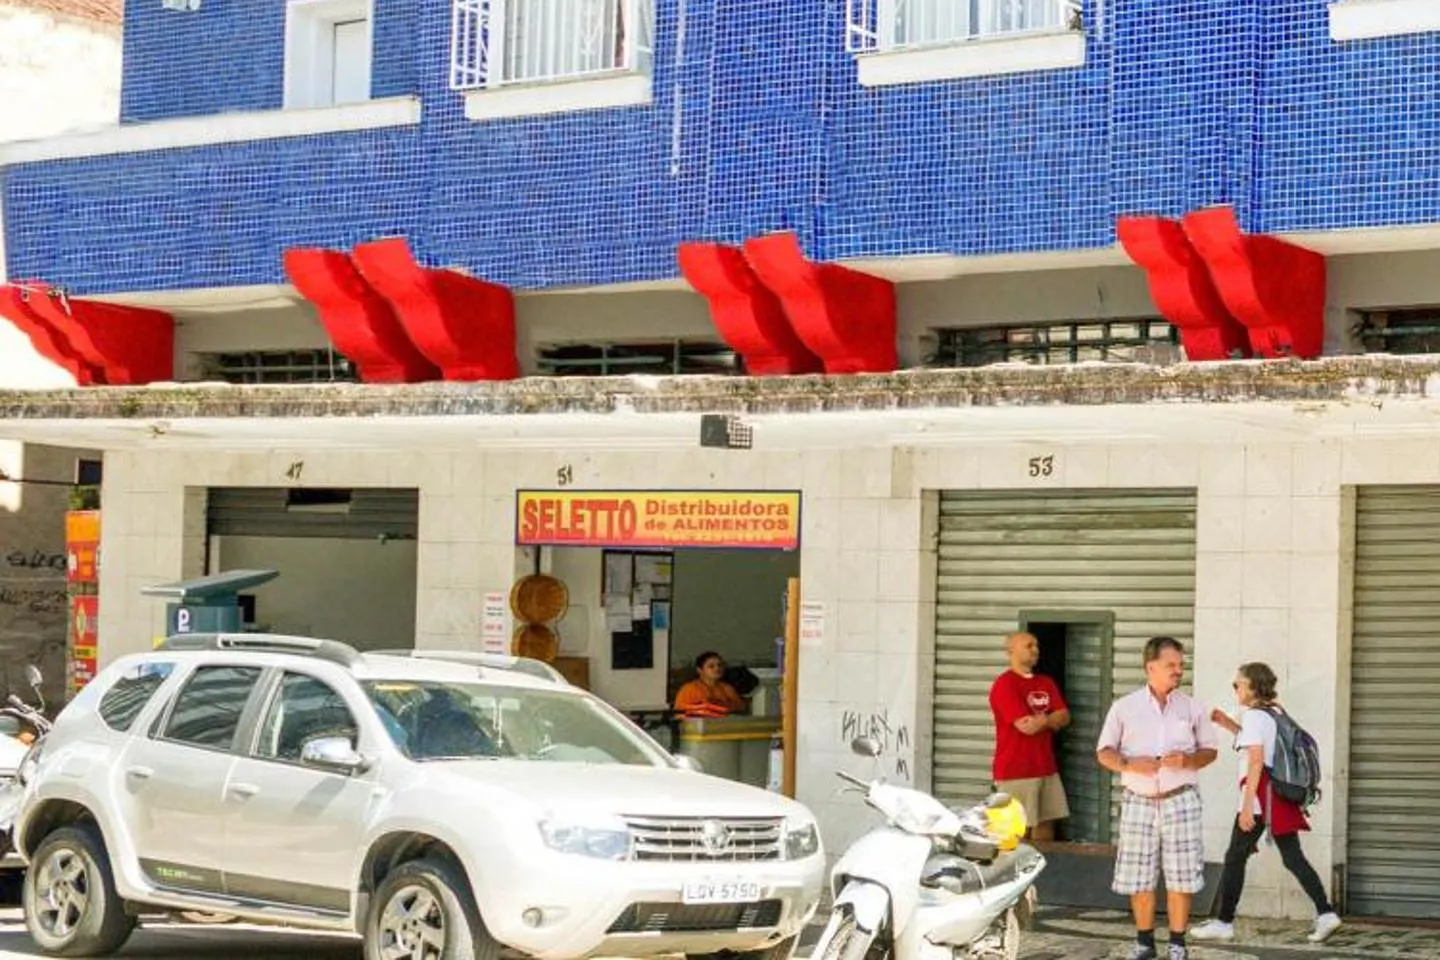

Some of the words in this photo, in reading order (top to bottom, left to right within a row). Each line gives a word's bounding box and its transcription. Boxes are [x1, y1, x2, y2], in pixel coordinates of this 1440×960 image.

[557, 465, 573, 486] 51
[1028, 455, 1053, 477] 53
[645, 500, 789, 517] Distribuidora
[522, 499, 637, 540] SELETTO
[645, 519, 667, 531] de
[673, 518, 789, 532] ALIMENTOS
